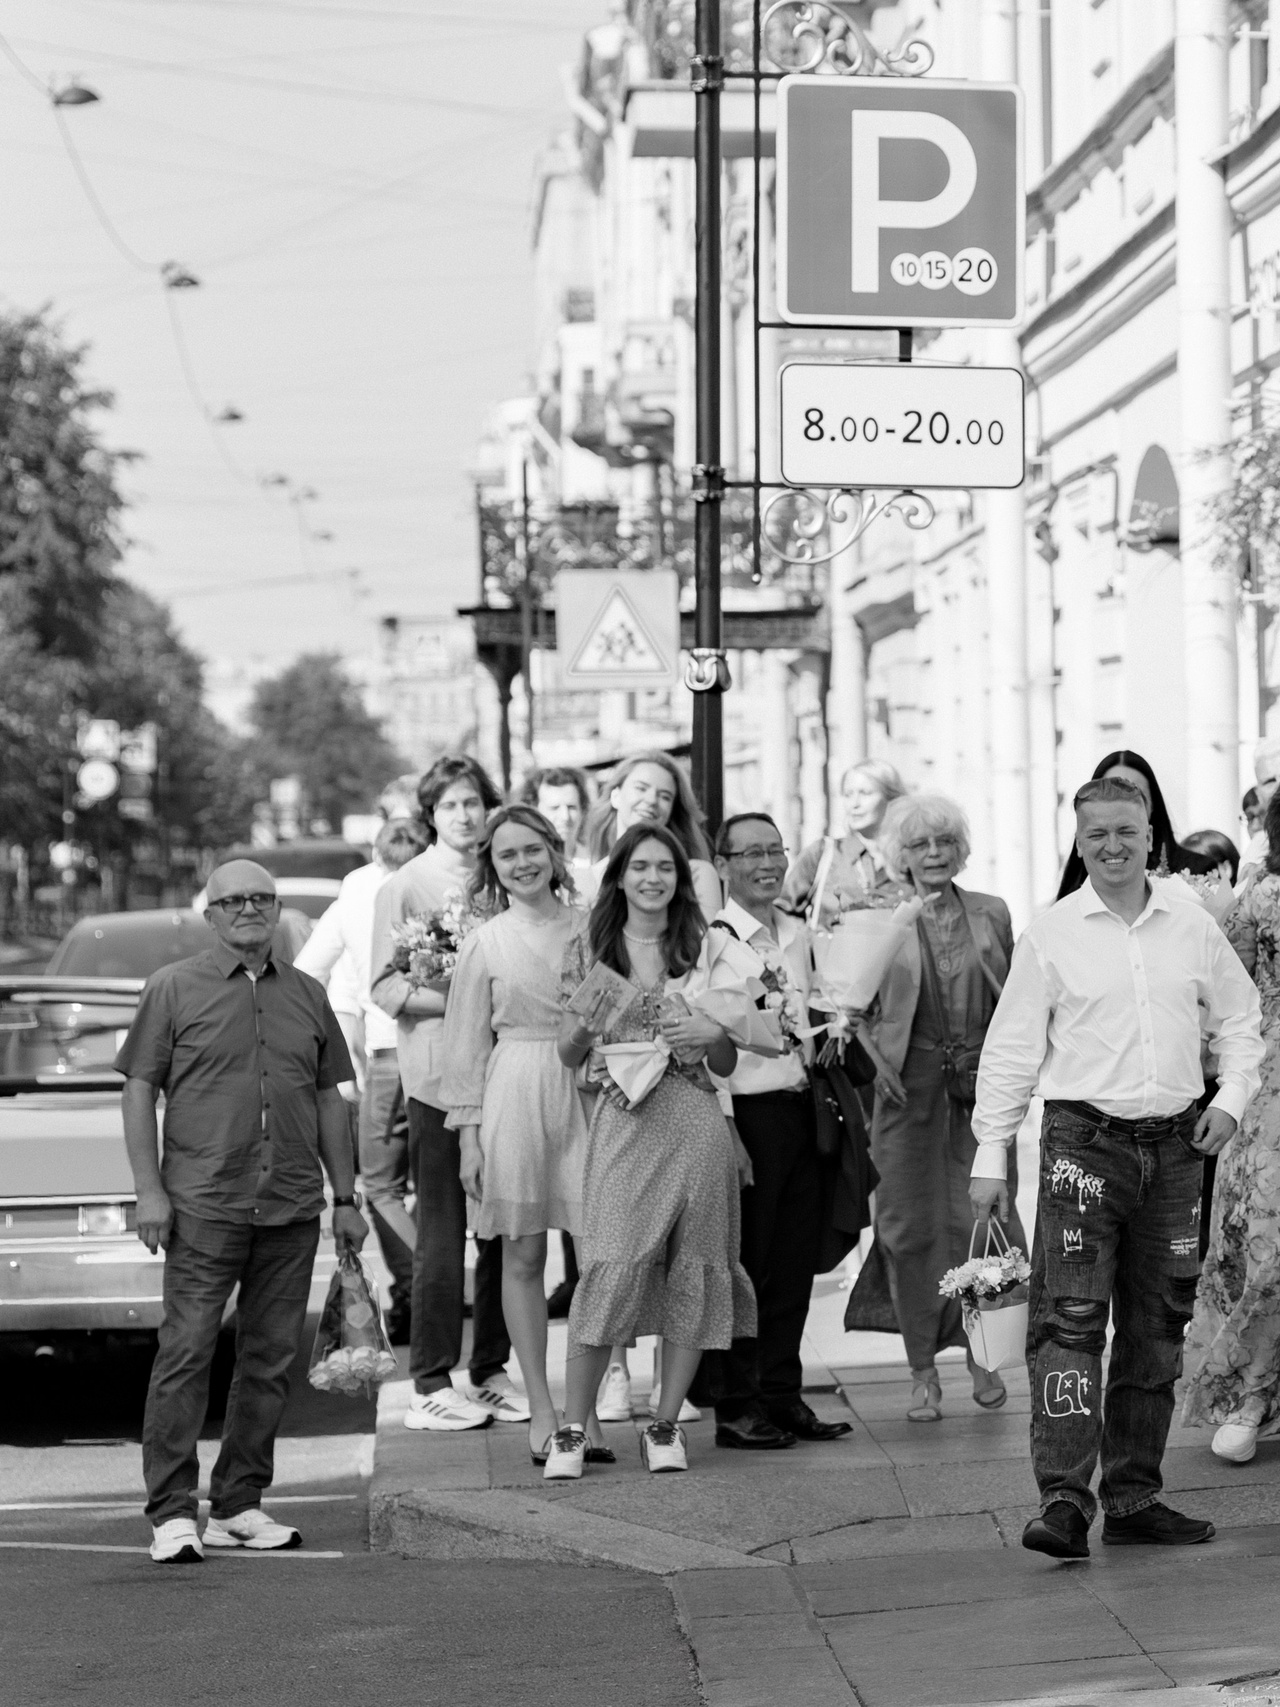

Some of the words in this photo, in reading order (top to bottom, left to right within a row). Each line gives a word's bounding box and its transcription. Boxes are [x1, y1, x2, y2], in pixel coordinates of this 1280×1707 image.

[851, 109, 978, 294] P
[900, 261, 917, 278] 10
[926, 260, 947, 280] 15
[958, 258, 993, 283] 20
[803, 407, 1004, 446] 8.00-20.00
